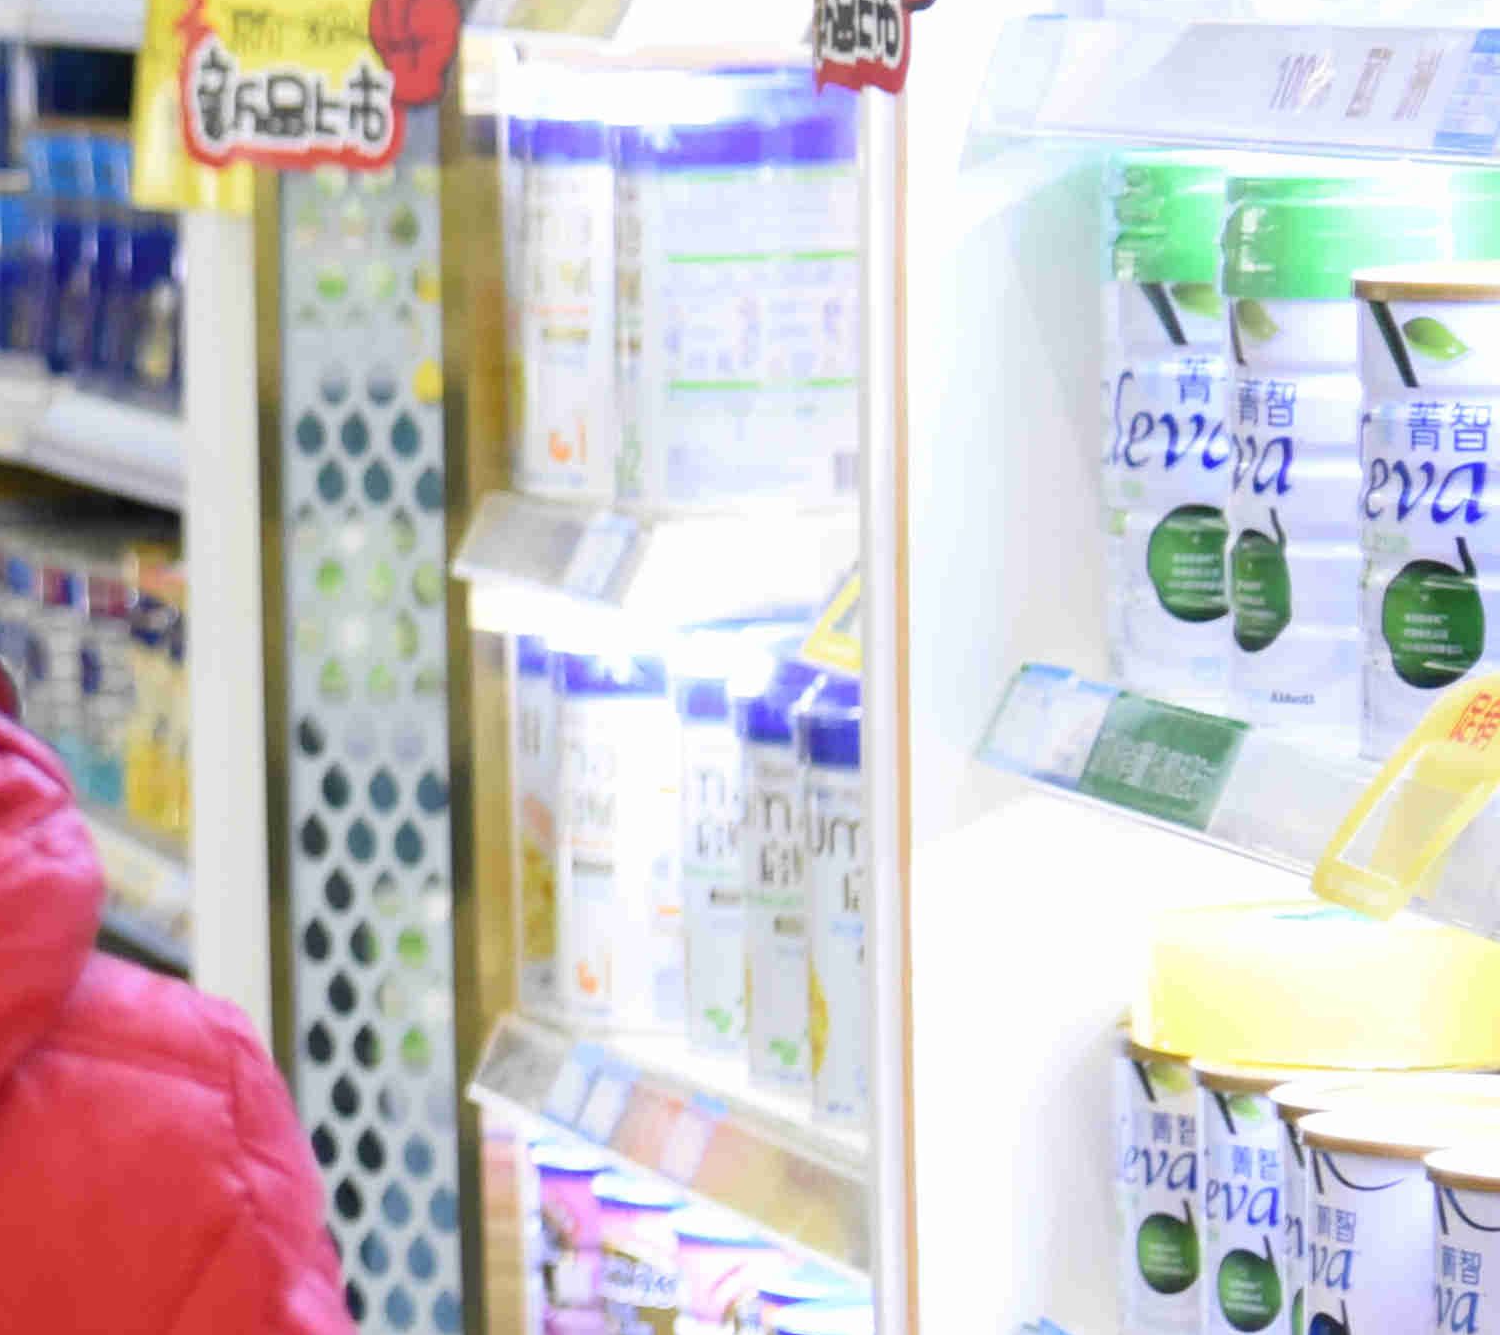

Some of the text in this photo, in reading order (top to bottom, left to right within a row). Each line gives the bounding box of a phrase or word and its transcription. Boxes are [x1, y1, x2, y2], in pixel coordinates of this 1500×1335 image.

[198, 46, 386, 142] 新品上市
[1406, 402, 1493, 453] 菁智
